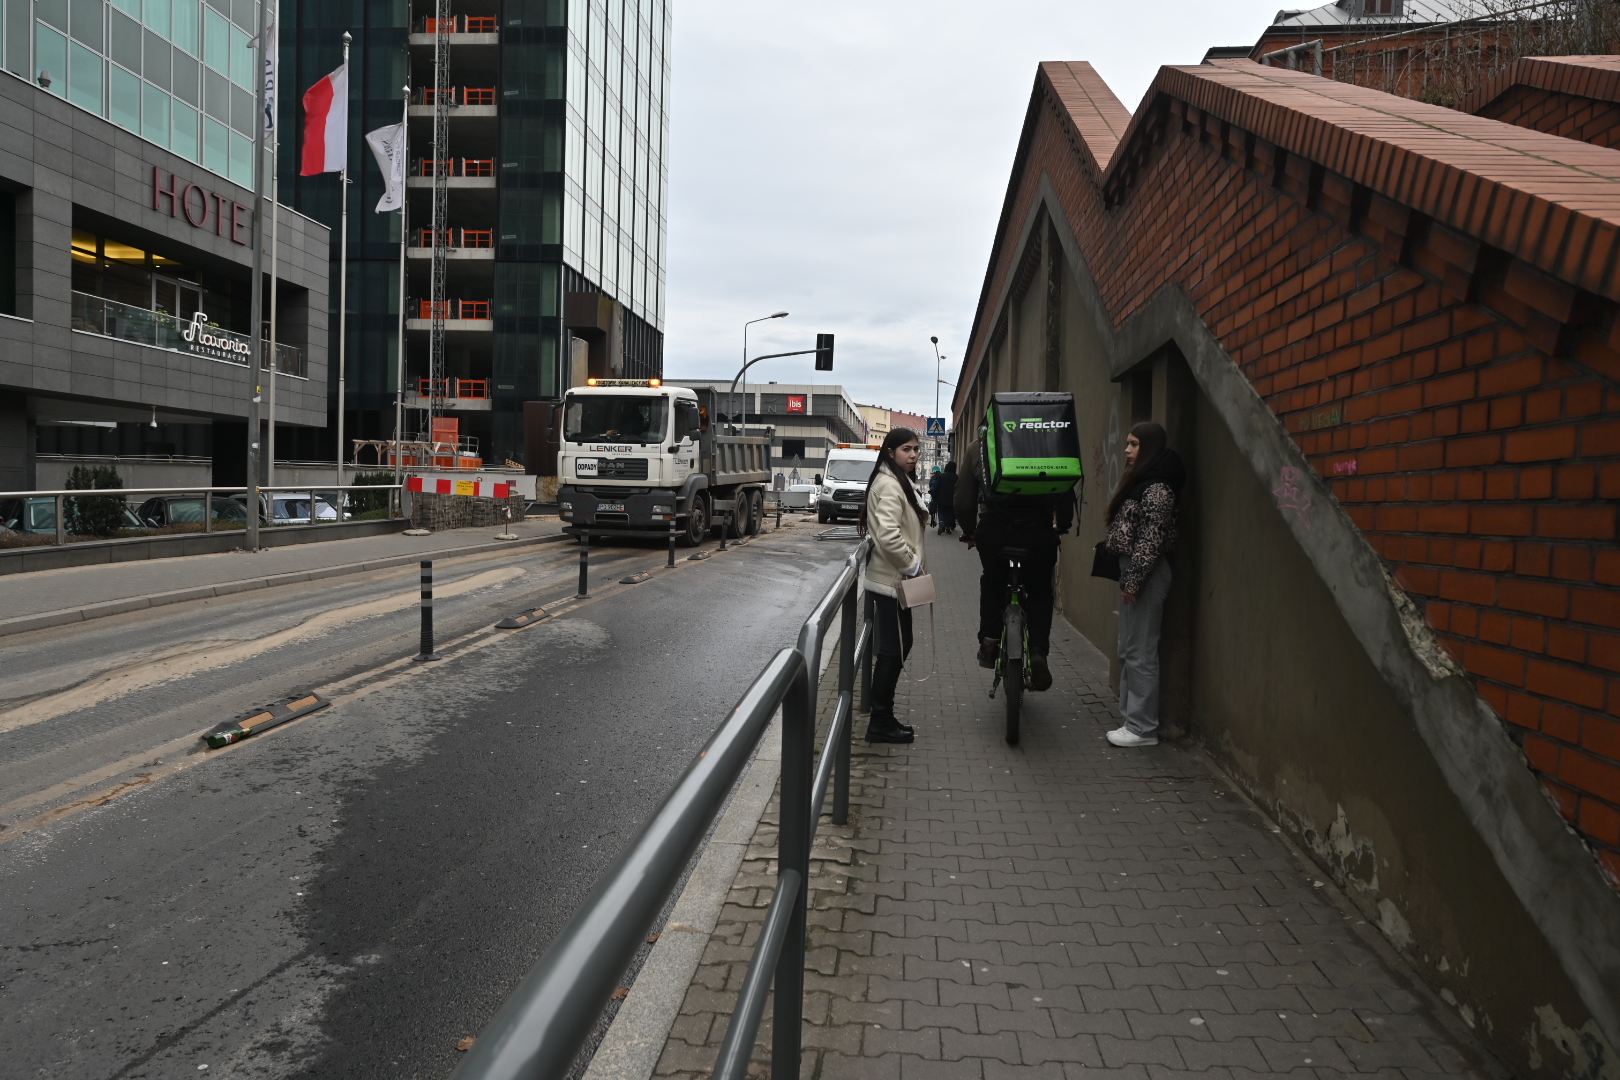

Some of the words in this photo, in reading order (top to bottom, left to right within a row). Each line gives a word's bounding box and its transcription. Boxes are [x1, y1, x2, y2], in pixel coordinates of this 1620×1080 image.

[153, 166, 254, 249] HOTE
[182, 311, 251, 355] Flavoria
[190, 344, 246, 362] RESTAURACJA
[789, 399, 802, 408] ibis
[1019, 420, 1071, 429] reactor
[589, 445, 633, 453] LENKER
[577, 463, 597, 471] ODPADY
